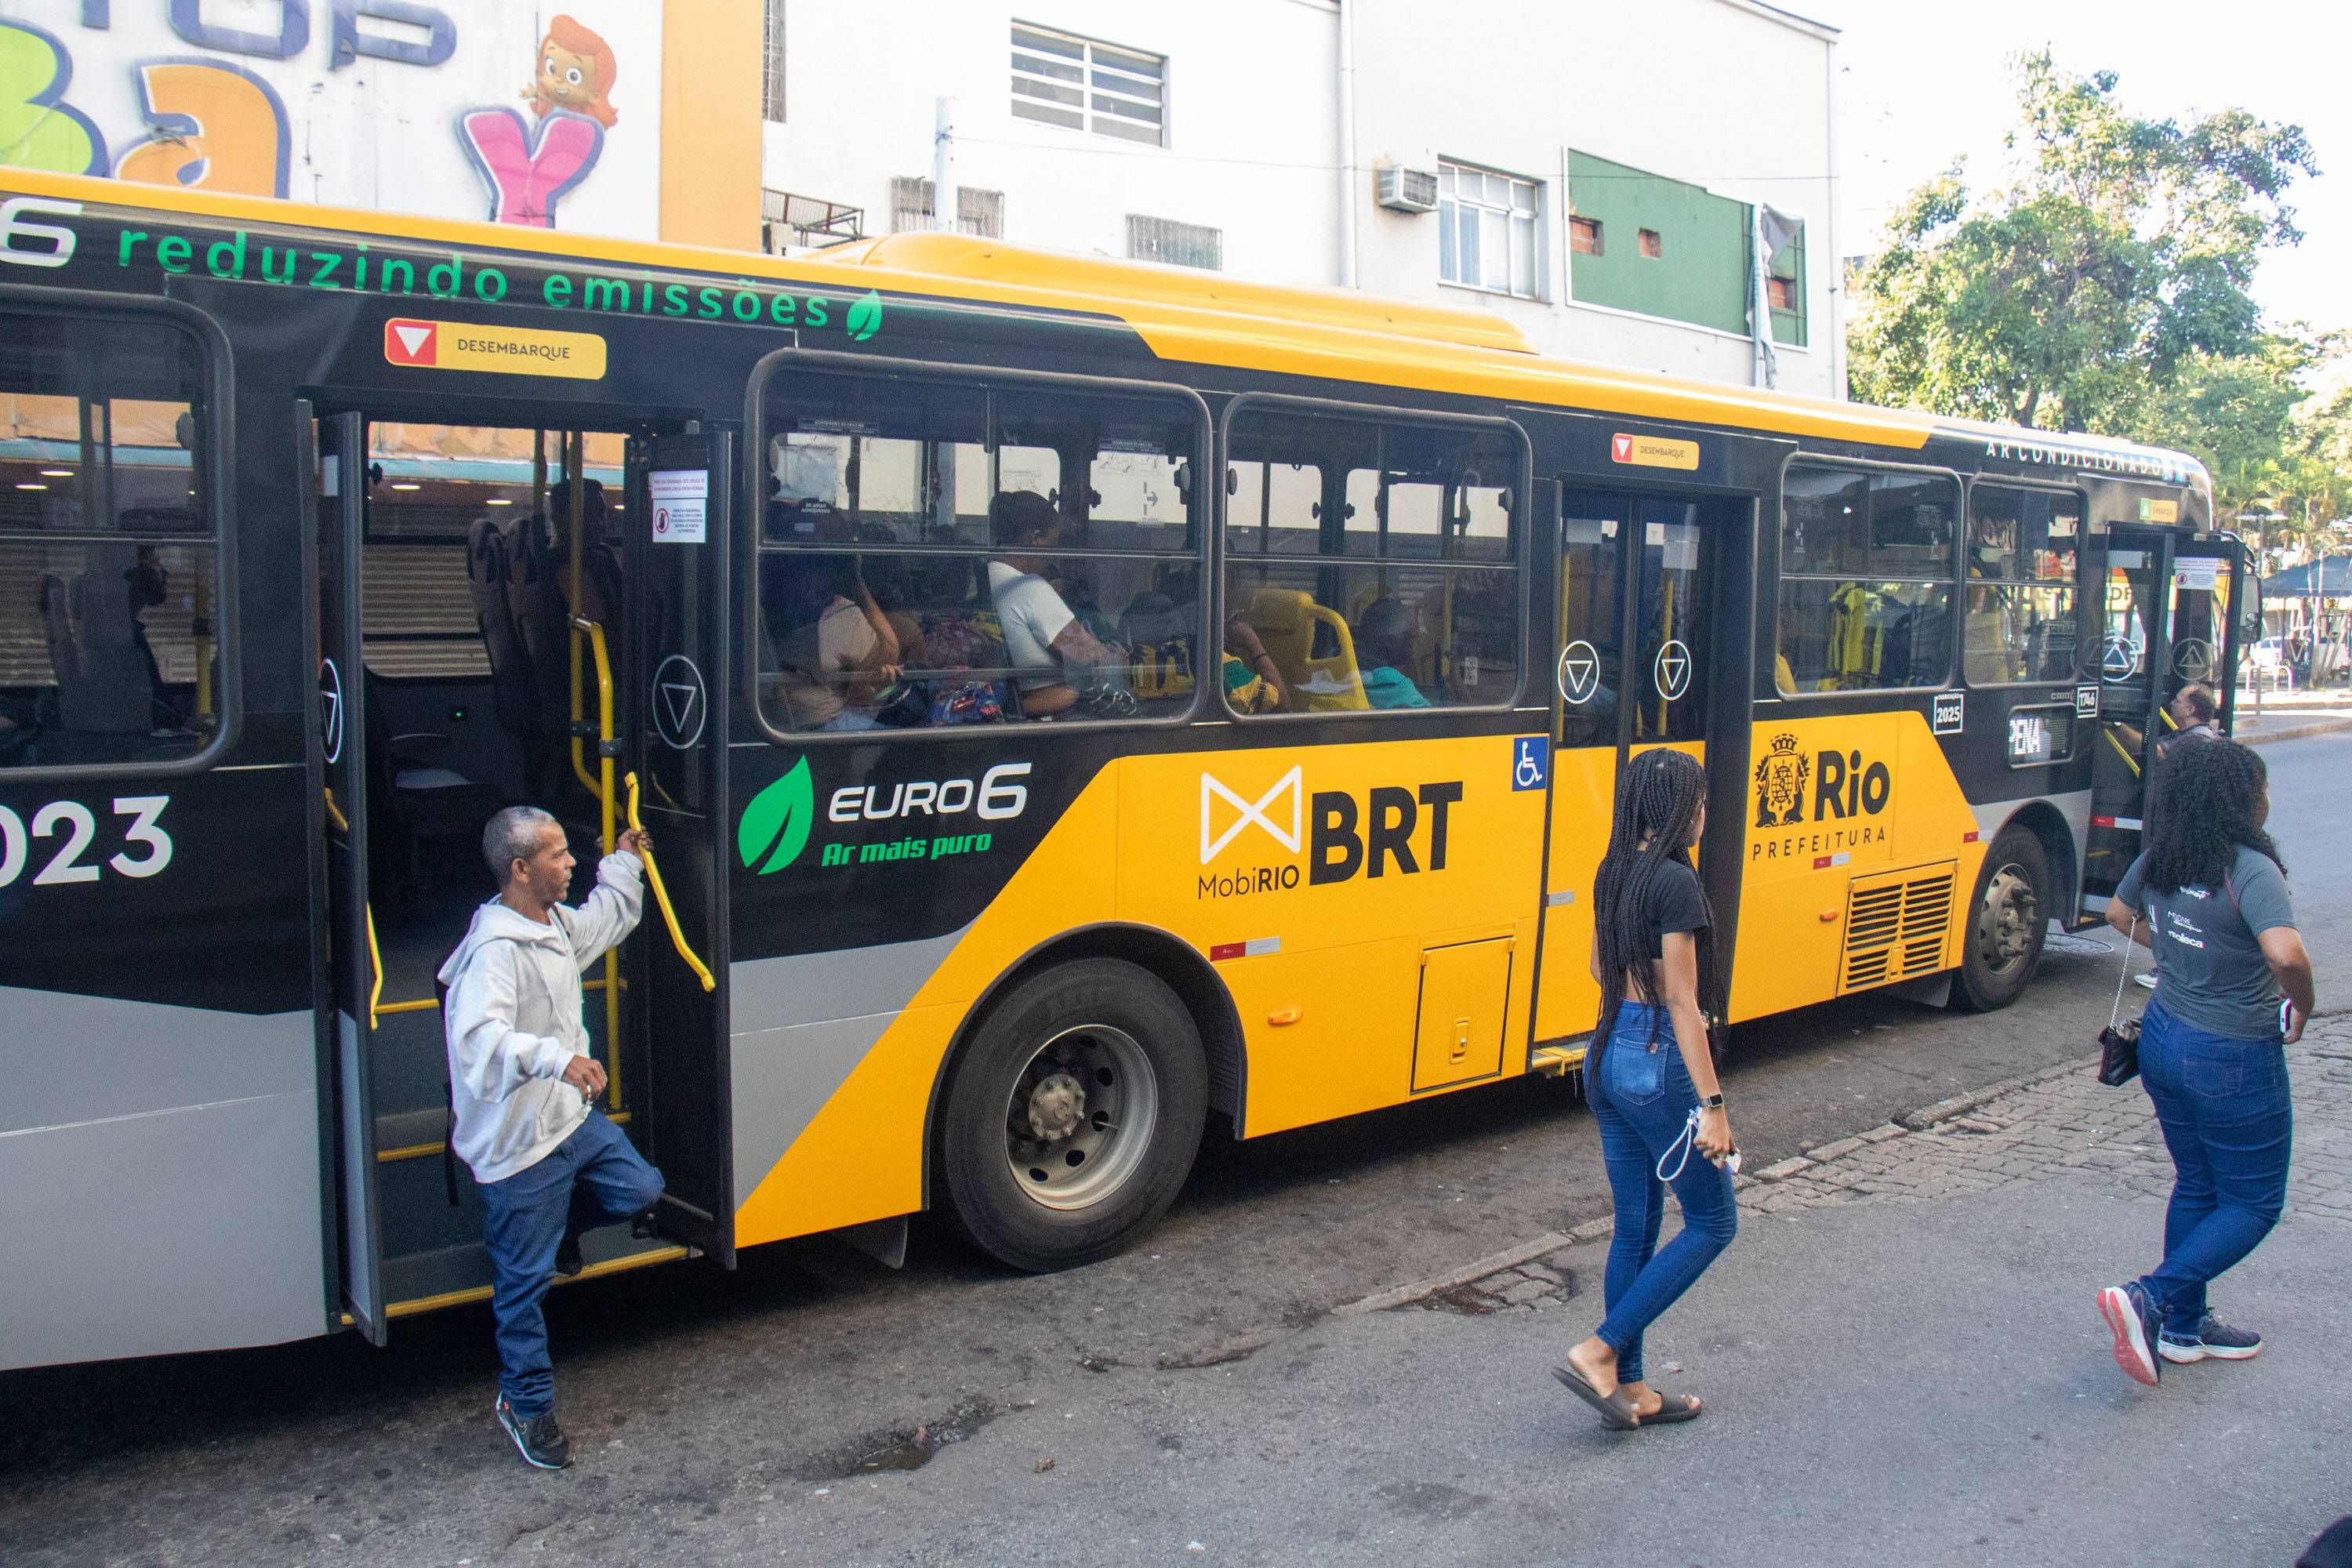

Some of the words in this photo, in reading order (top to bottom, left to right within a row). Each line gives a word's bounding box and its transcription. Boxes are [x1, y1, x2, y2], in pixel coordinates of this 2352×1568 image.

[119, 229, 508, 303] reduzindo
[543, 269, 829, 327] emissões
[458, 339, 571, 361] DESEMBARQUE
[1639, 445, 1685, 459] DESEMBARQUE
[1986, 440, 2009, 459] AR
[1936, 706, 1960, 724] 2025
[2079, 692, 2095, 706] 1746
[1814, 750, 1890, 822] Rio
[822, 844, 856, 866] Ar
[860, 837, 927, 863] mais
[931, 833, 992, 860] puro
[1309, 781, 1463, 886] BRT
[1752, 826, 1886, 862] PREFEITURA
[1198, 865, 1300, 900] MobiRIO
